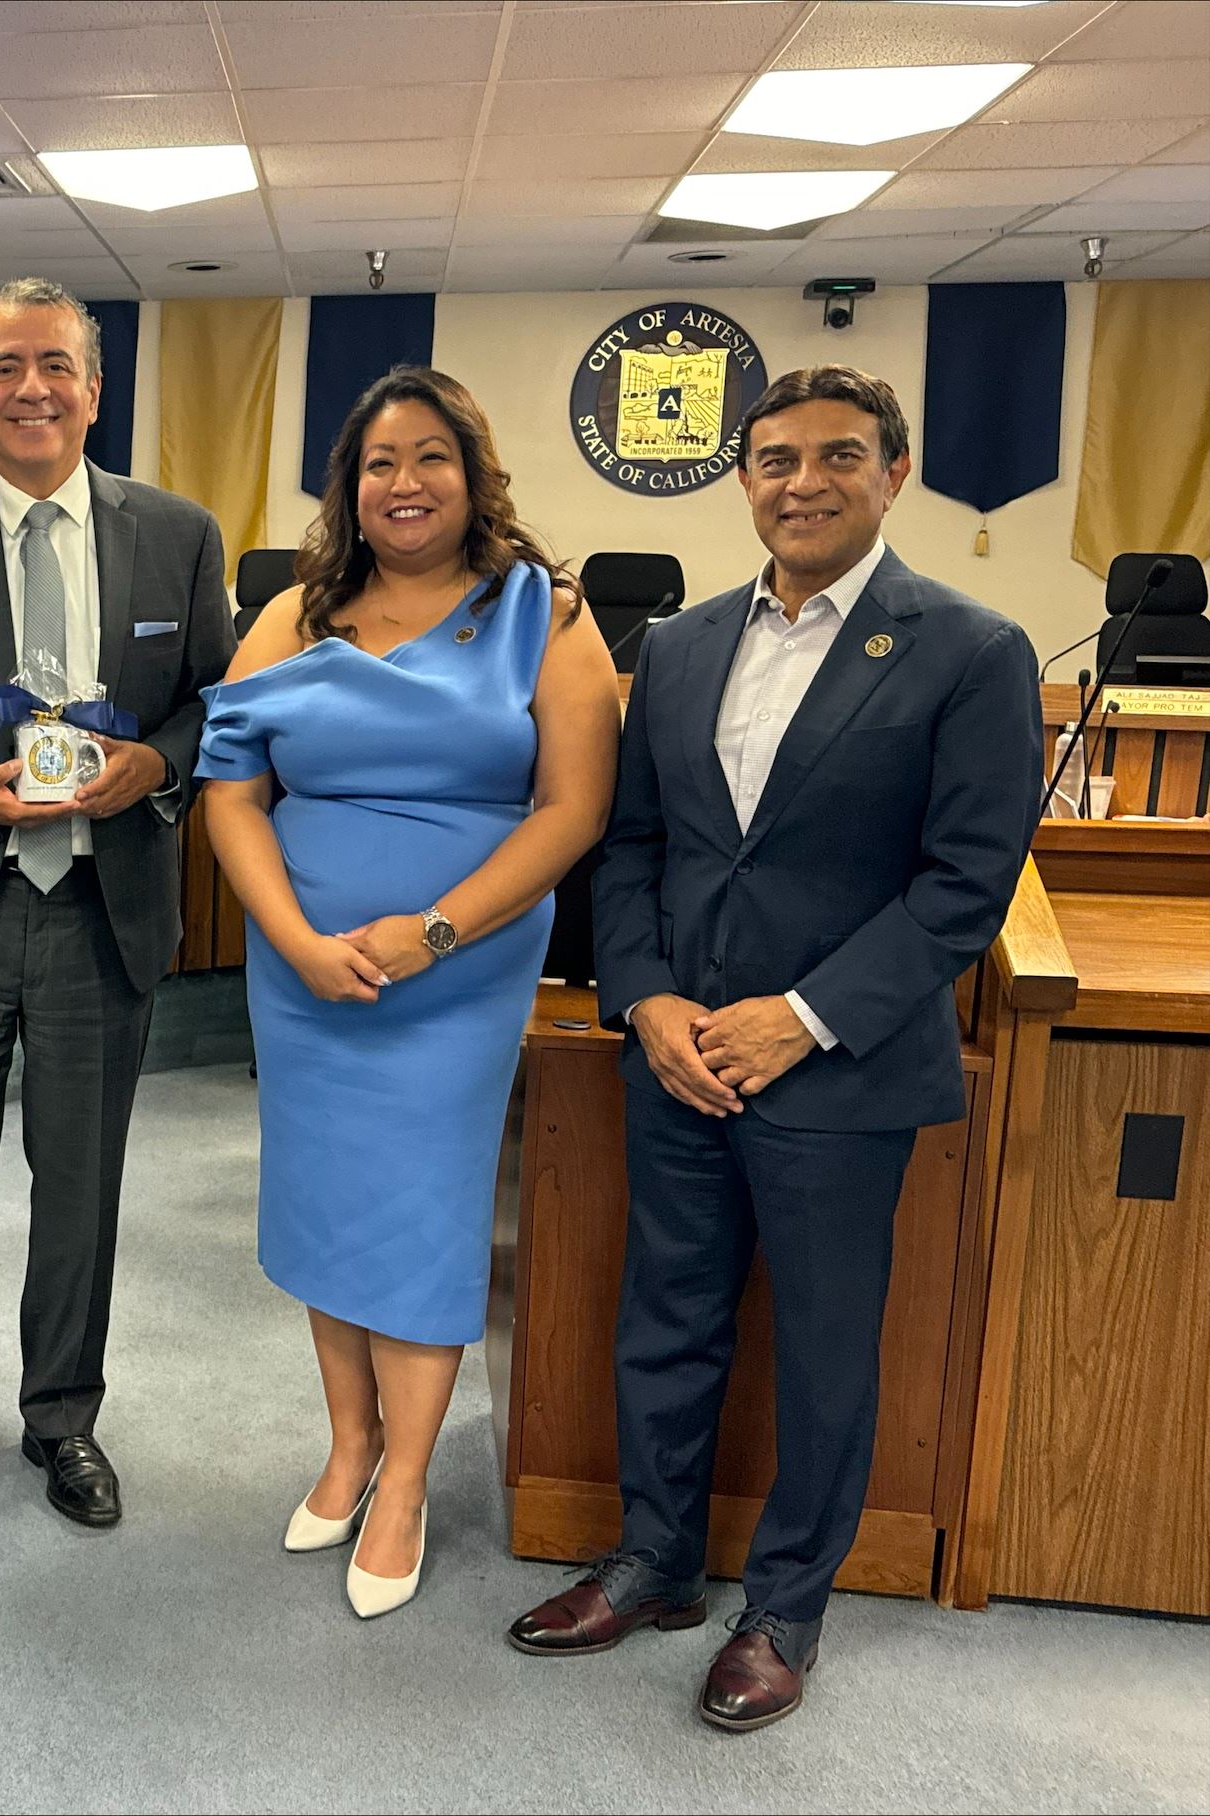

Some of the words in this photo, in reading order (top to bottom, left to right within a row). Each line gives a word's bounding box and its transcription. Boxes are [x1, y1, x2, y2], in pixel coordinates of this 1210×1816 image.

[588, 326, 631, 372] CITY
[639, 309, 667, 331] OF
[679, 309, 758, 371] ARTESIA
[659, 394, 681, 412] A
[578, 414, 618, 471] STATE
[618, 464, 646, 485] OF
[649, 425, 742, 490] CALIFORN
[630, 447, 683, 456] INCORPORATED
[1121, 702, 1149, 710] AYOR
[1153, 703, 1175, 711] PRO
[1181, 704, 1203, 712] TEM
